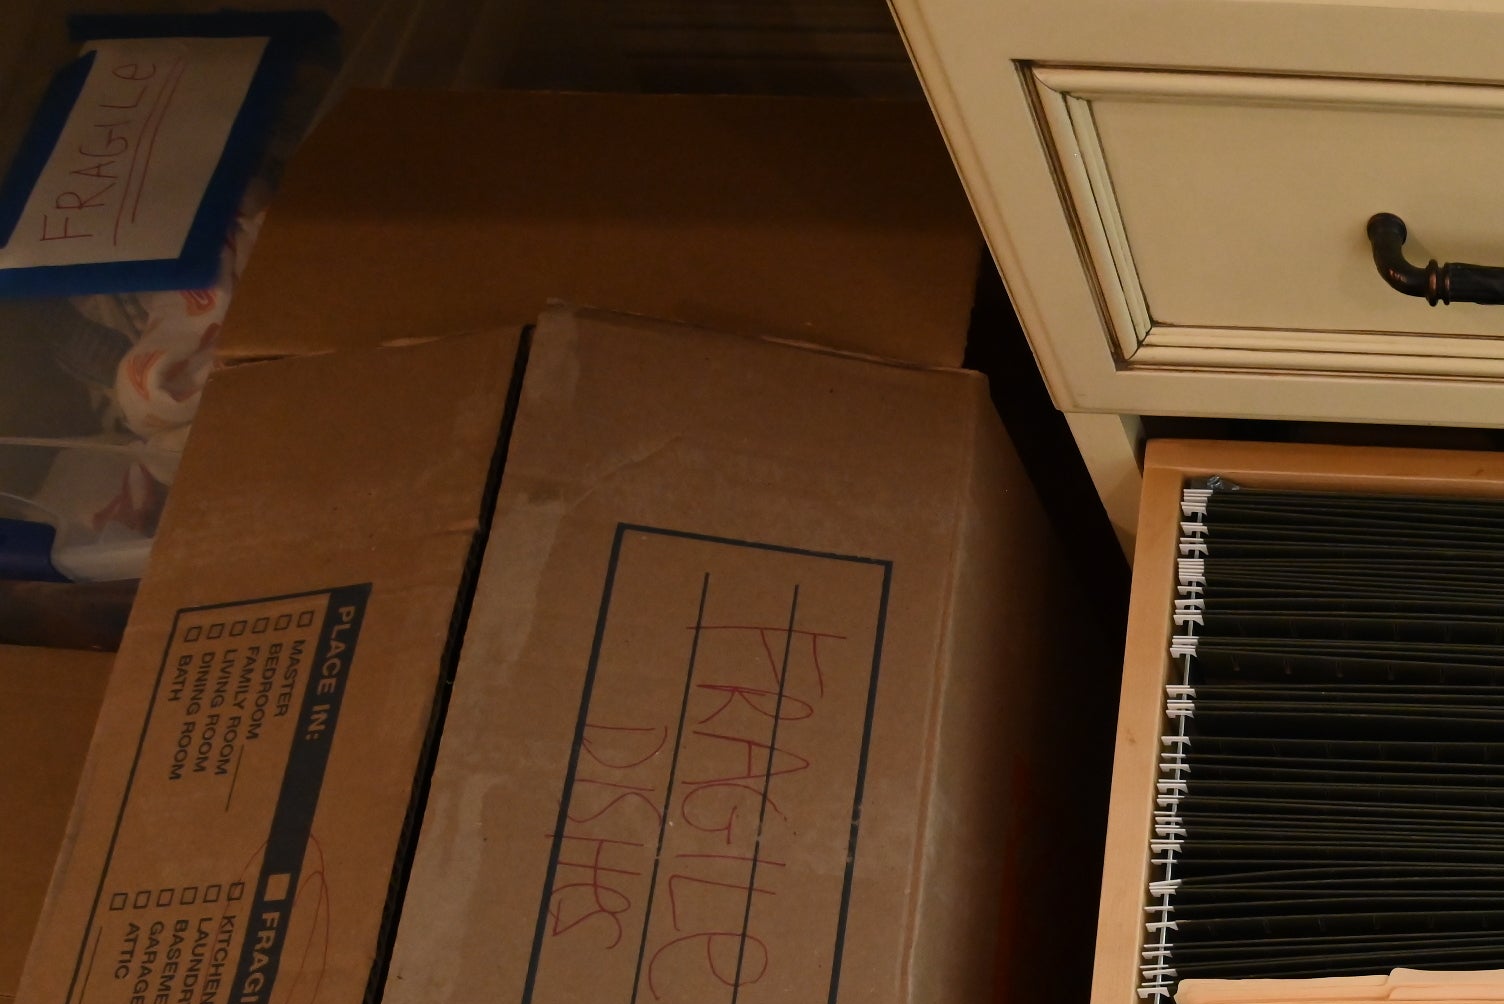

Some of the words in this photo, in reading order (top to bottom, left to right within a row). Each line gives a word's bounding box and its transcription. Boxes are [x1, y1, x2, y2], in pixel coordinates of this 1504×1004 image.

[167, 654, 193, 702] BATH
[210, 648, 239, 709] LIVING
[232, 646, 261, 711] FAMILY
[273, 639, 306, 718] MASTER
[316, 606, 356, 696] PLACE
[186, 652, 215, 715] DINING
[246, 643, 284, 741] BEDROOM
[168, 721, 196, 781] ROOM
[192, 714, 220, 773] ROOM
[214, 716, 242, 776] ROOM
[304, 704, 331, 741] IN:
[113, 922, 140, 980] ATTIC
